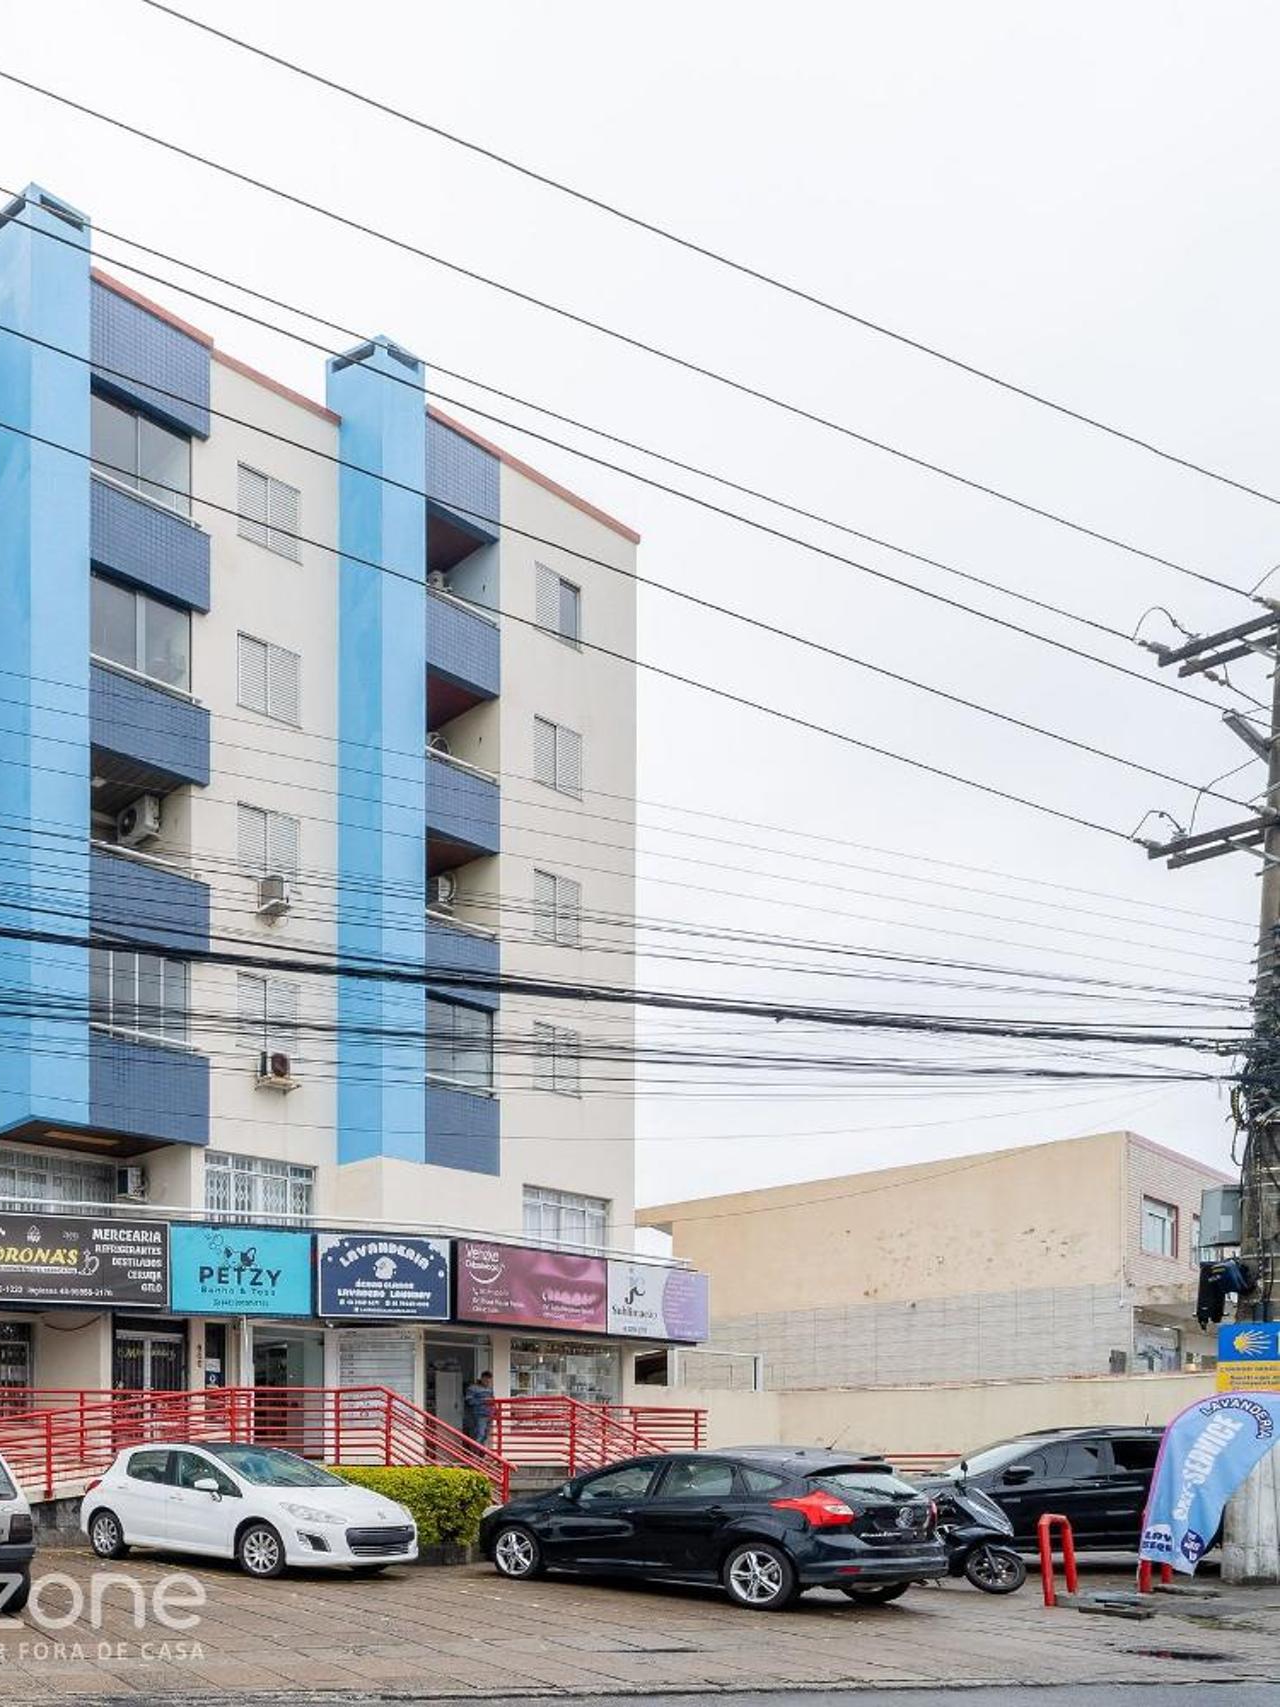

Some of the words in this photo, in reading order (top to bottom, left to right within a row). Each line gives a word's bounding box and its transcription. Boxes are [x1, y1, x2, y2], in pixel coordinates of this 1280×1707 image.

[92, 1228, 162, 1243] MERCEARIA
[111, 1257, 162, 1268] DESTILADOS
[339, 1242, 430, 1271] LAVANDERIA
[198, 1265, 282, 1287] PETZY
[200, 1285, 235, 1295] Banho
[1200, 1397, 1274, 1440] LAVANDERIA
